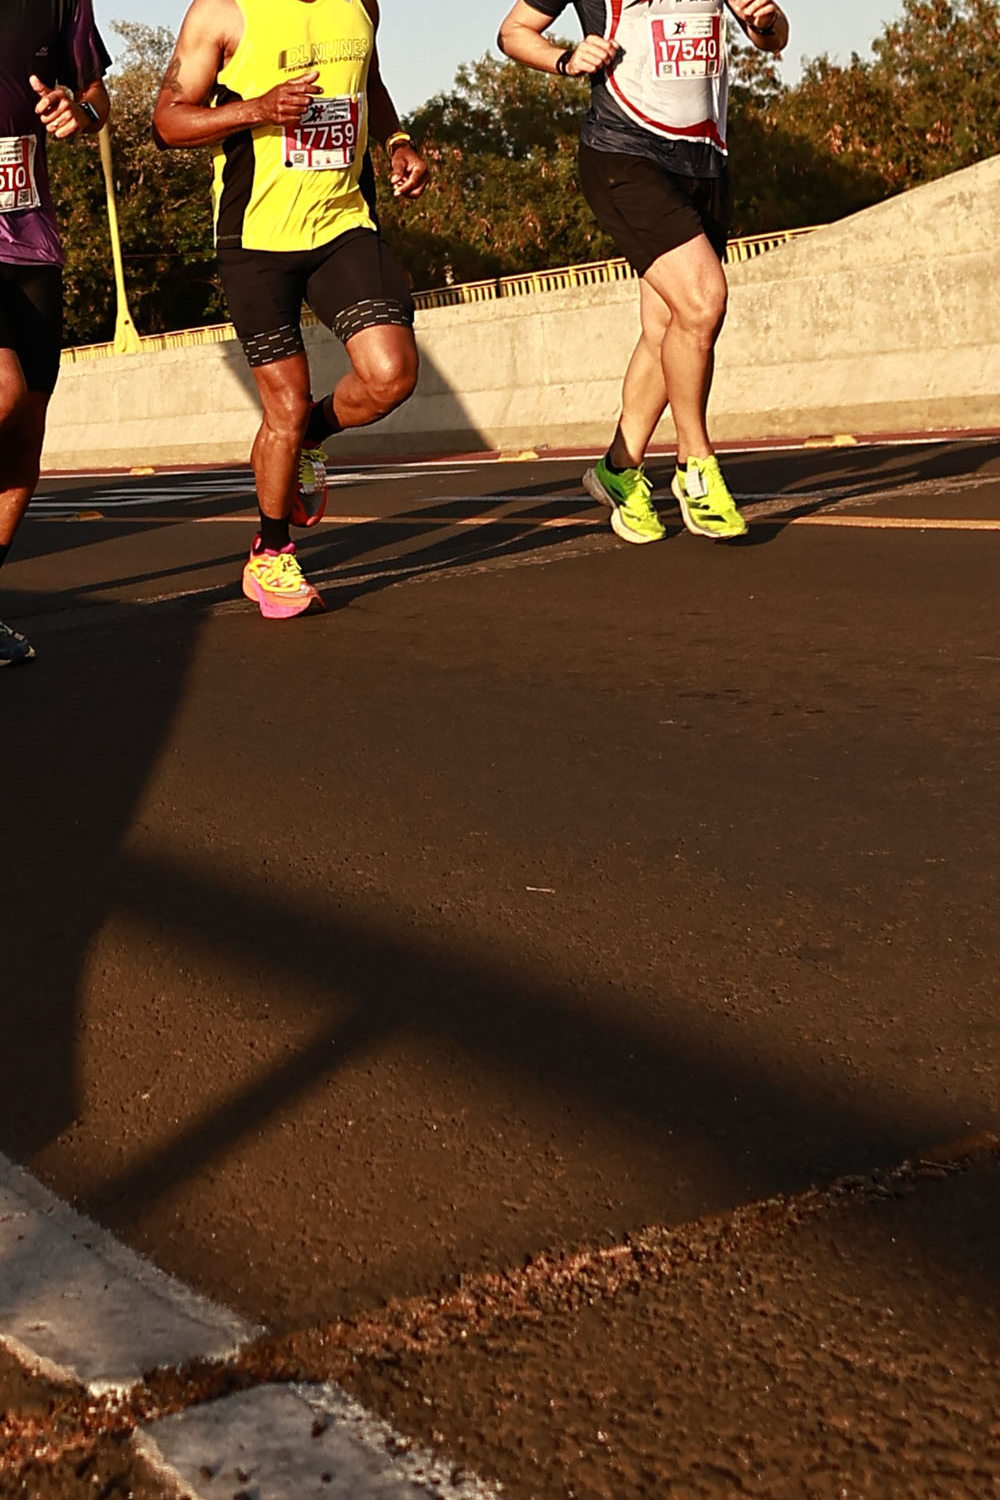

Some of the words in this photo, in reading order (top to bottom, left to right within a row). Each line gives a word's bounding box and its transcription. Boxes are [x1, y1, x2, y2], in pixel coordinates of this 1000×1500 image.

[311, 37, 369, 60] NUNES
[658, 39, 717, 62] 17540
[294, 123, 355, 150] 17759
